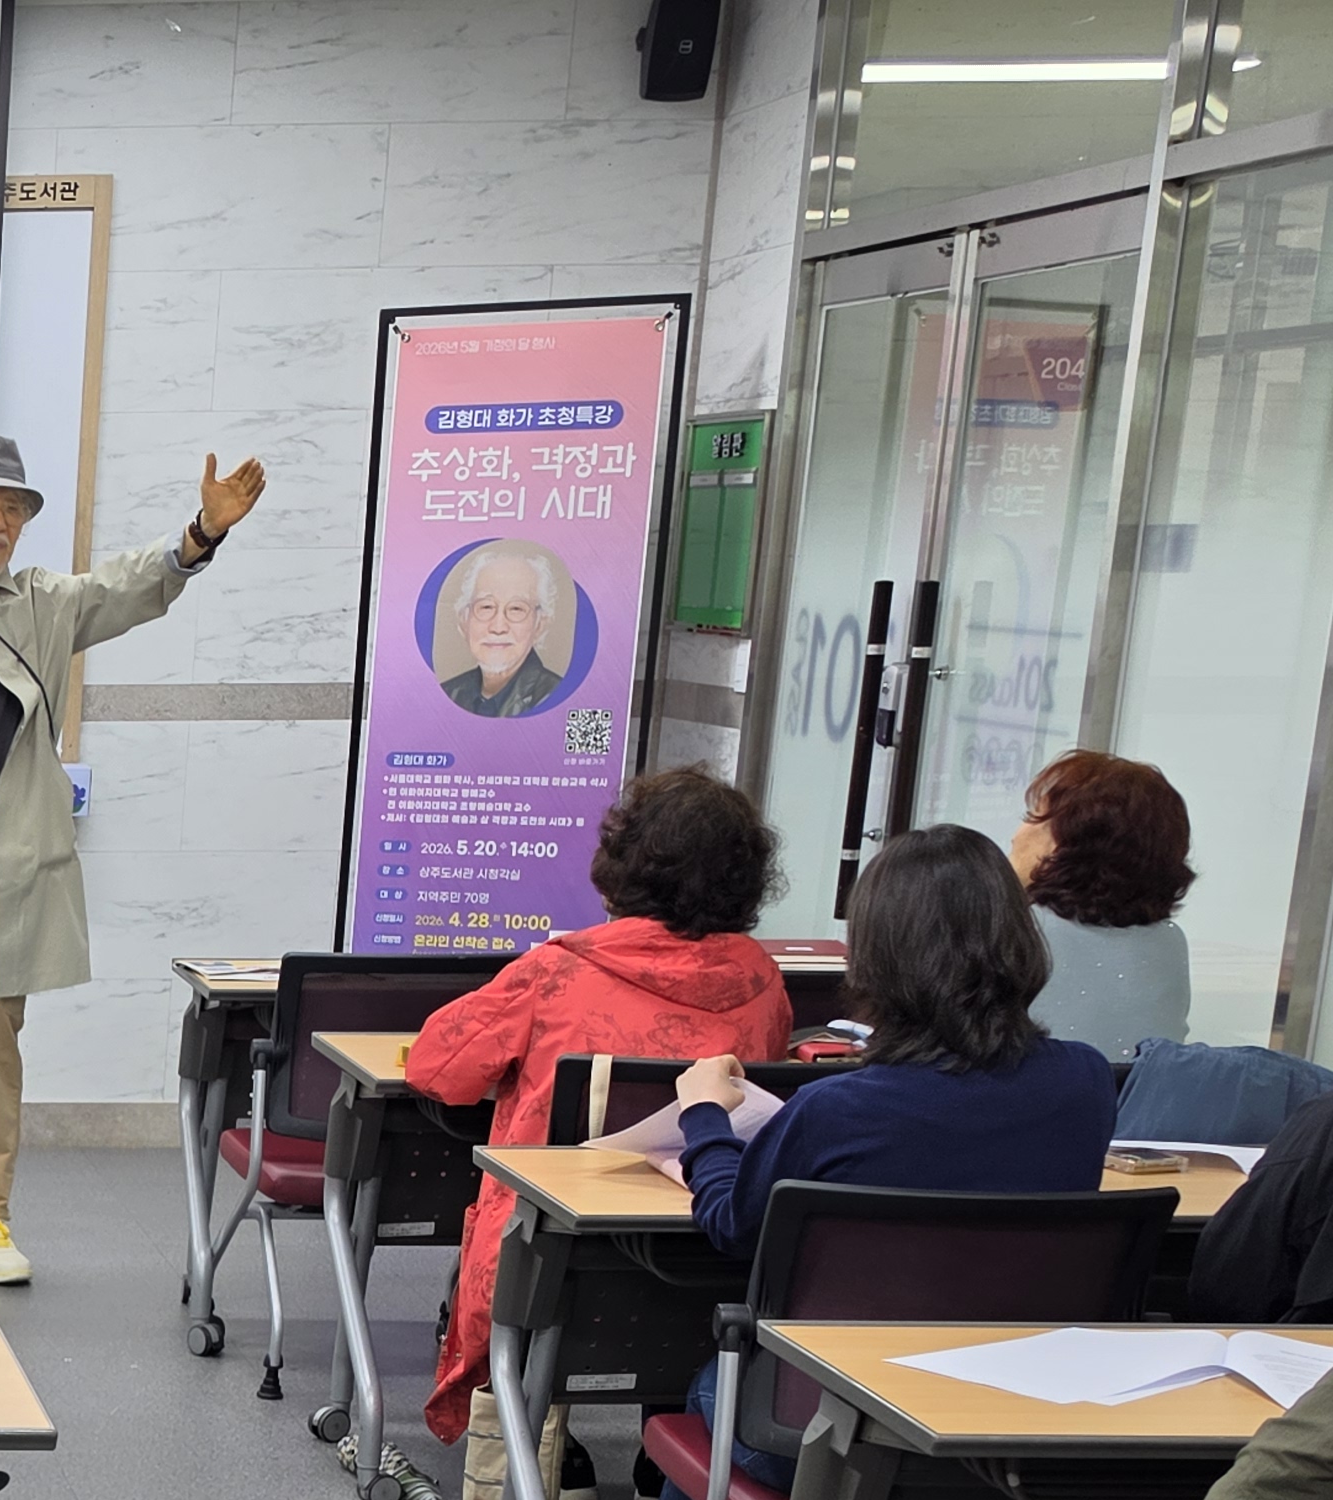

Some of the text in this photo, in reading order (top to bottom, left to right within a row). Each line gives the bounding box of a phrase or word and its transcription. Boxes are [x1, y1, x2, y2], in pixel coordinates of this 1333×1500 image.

[1041, 357, 1085, 379] 204
[437, 404, 614, 430] 김형대 화가 초청특강
[712, 432, 743, 458] 알림판
[408, 442, 637, 483] 추상화, 격정과
[422, 483, 613, 521] 도전의 시대
[420, 843, 454, 855] 2026.
[456, 840, 471, 856] 5.
[510, 841, 558, 858] 14:00
[419, 866, 474, 880] 상주도서관
[476, 868, 521, 881] 시청각실
[417, 890, 461, 903] 지역주민
[464, 892, 490, 904] 70명
[415, 914, 445, 927] 2026.
[448, 912, 464, 927] 4.
[467, 912, 493, 928] 28.
[503, 913, 551, 931] 10:00
[413, 934, 450, 948] 온라인
[452, 935, 489, 949] 선착순
[491, 937, 516, 950] 접수
